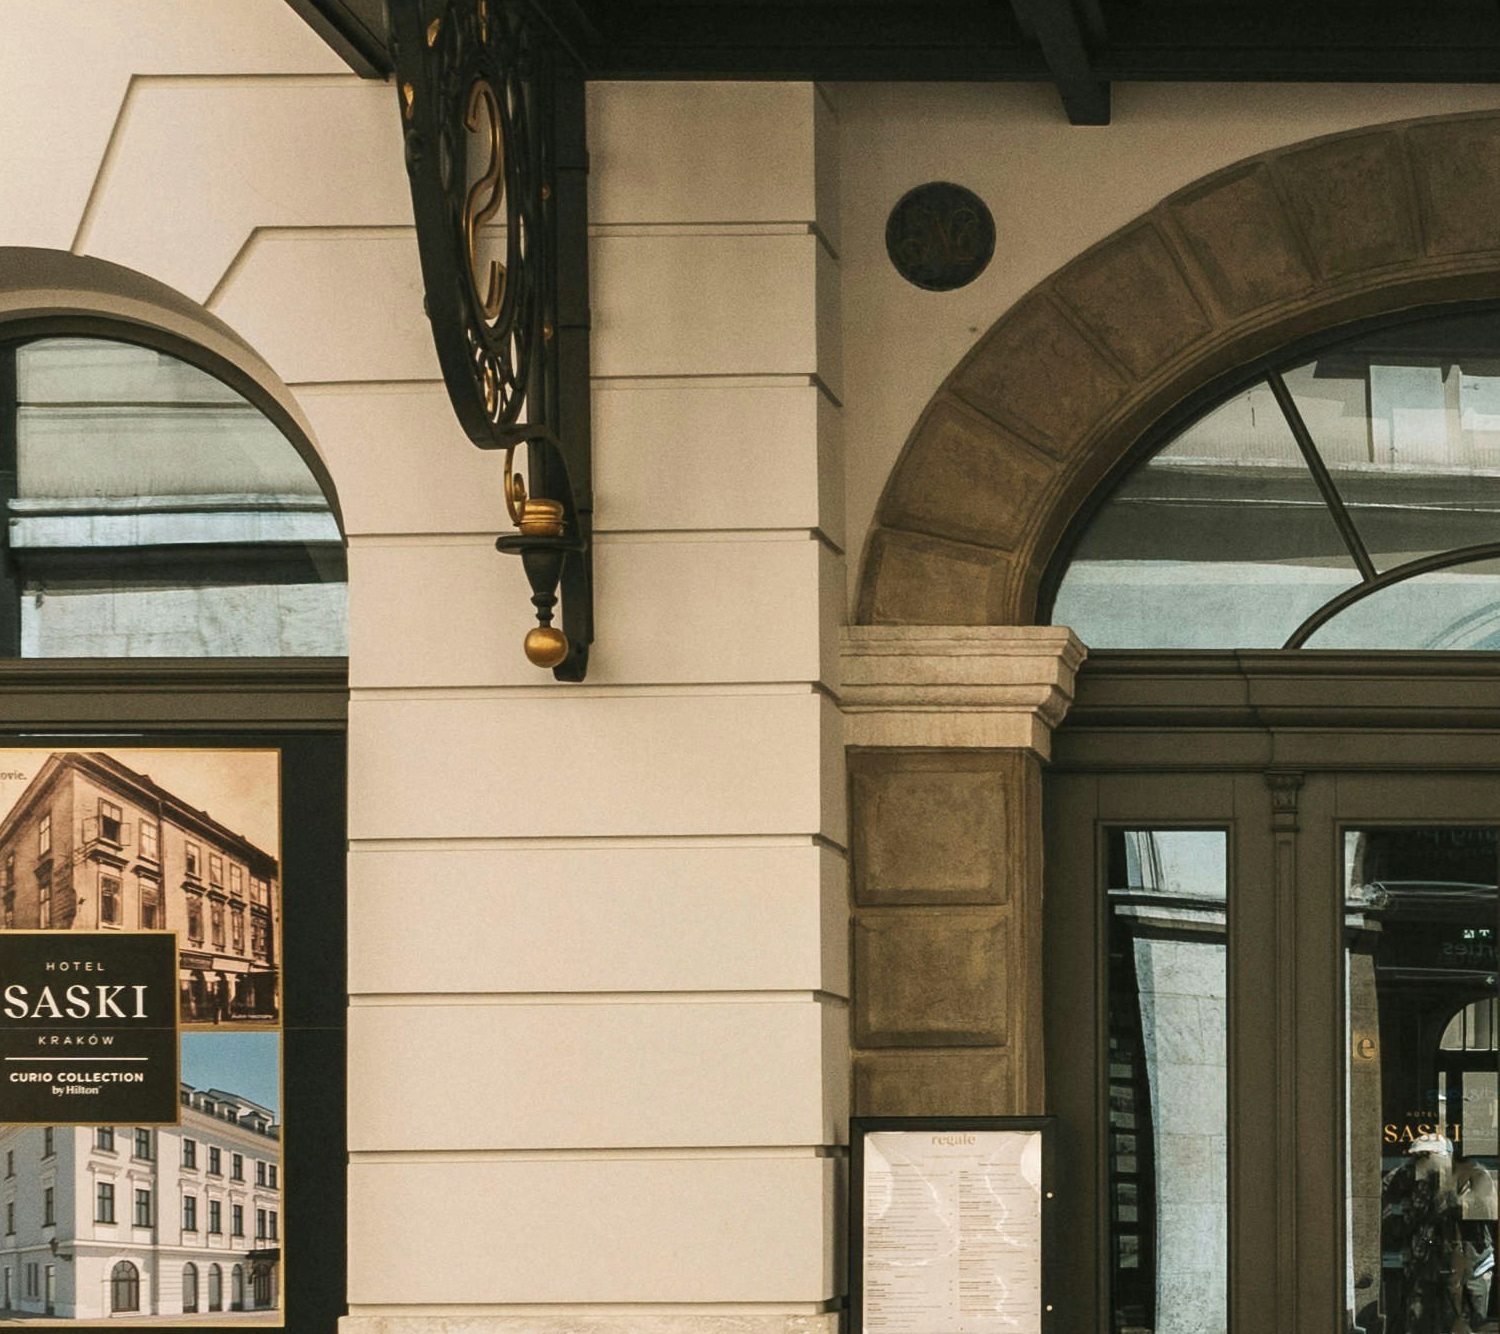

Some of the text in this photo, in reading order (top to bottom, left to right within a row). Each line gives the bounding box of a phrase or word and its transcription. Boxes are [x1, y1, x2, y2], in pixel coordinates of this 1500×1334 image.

[46, 961, 106, 972] HOTEL
[3, 984, 149, 1019] SASKI
[38, 1033, 115, 1045] KRAKÓW
[9, 1072, 145, 1083] CURIO COLLECTION
[51, 1085, 100, 1097] by Hilton
